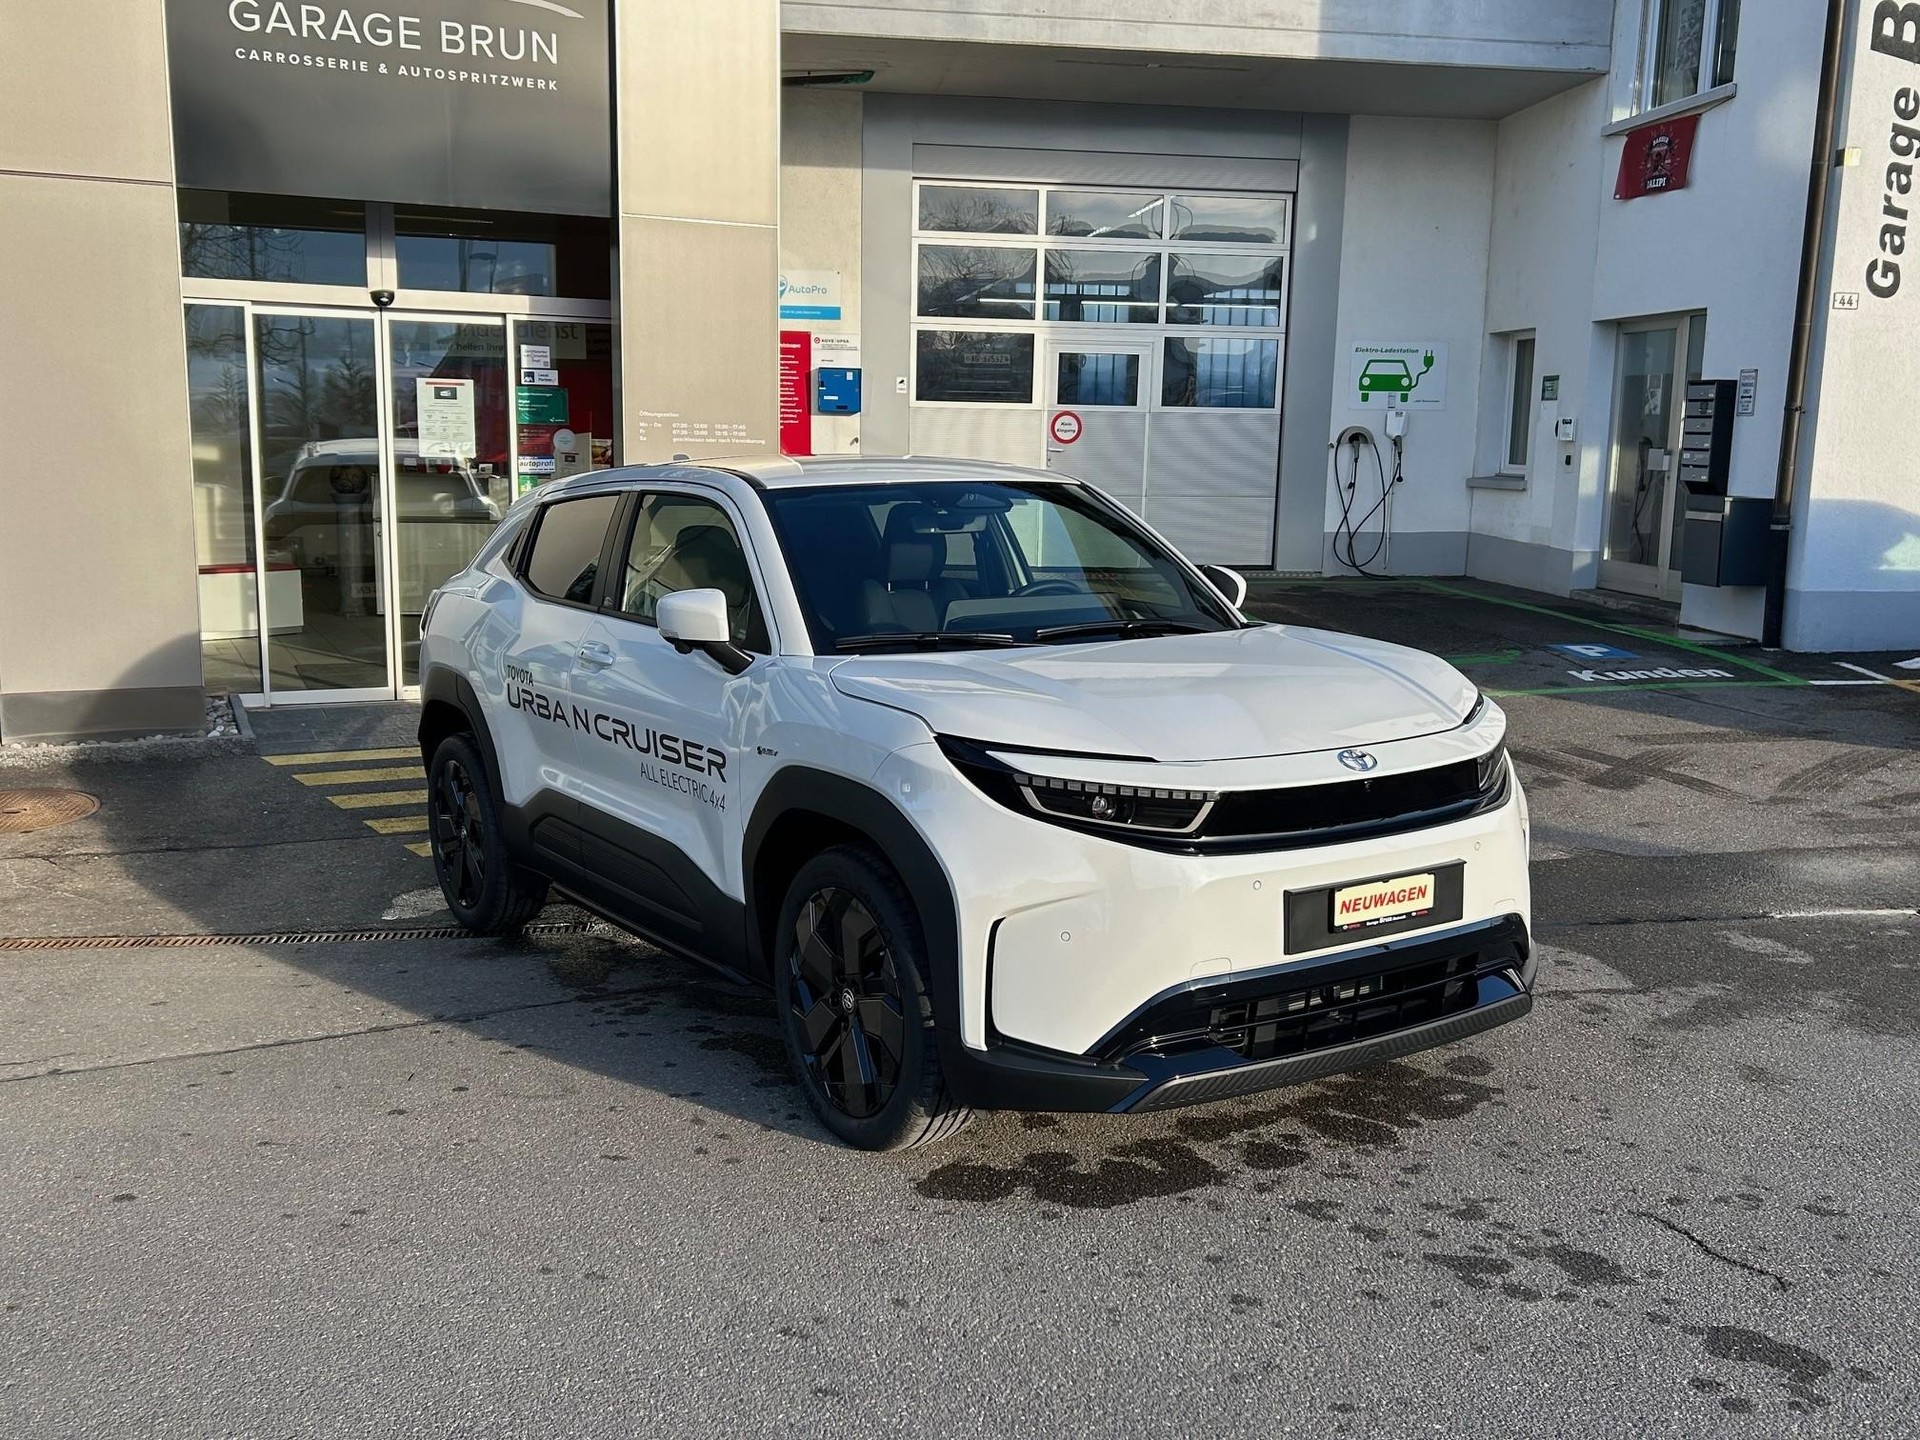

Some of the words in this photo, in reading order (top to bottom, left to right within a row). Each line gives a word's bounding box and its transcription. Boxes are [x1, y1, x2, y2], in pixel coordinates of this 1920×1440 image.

[228, 0, 422, 51] GARAGE
[440, 20, 558, 65] BRUN
[235, 47, 369, 72] CARROSSERIE
[378, 63, 388, 75] &
[398, 64, 558, 91] AUTOSPRITZWERK
[1865, 86, 1920, 299] Garage
[788, 285, 828, 295] AutoPro
[1838, 295, 1854, 307] 44
[1355, 347, 1420, 355] Elektro-Ladestation
[519, 460, 555, 468] autoprofi
[507, 664, 535, 687] TOYOTA
[1566, 667, 1735, 682] Kunden
[593, 712, 728, 783] CRUISER
[640, 761, 660, 784] ALL
[659, 768, 709, 805] ELECTRIC
[709, 788, 727, 814] 4x4
[1340, 884, 1428, 915] NEUWAGEN
